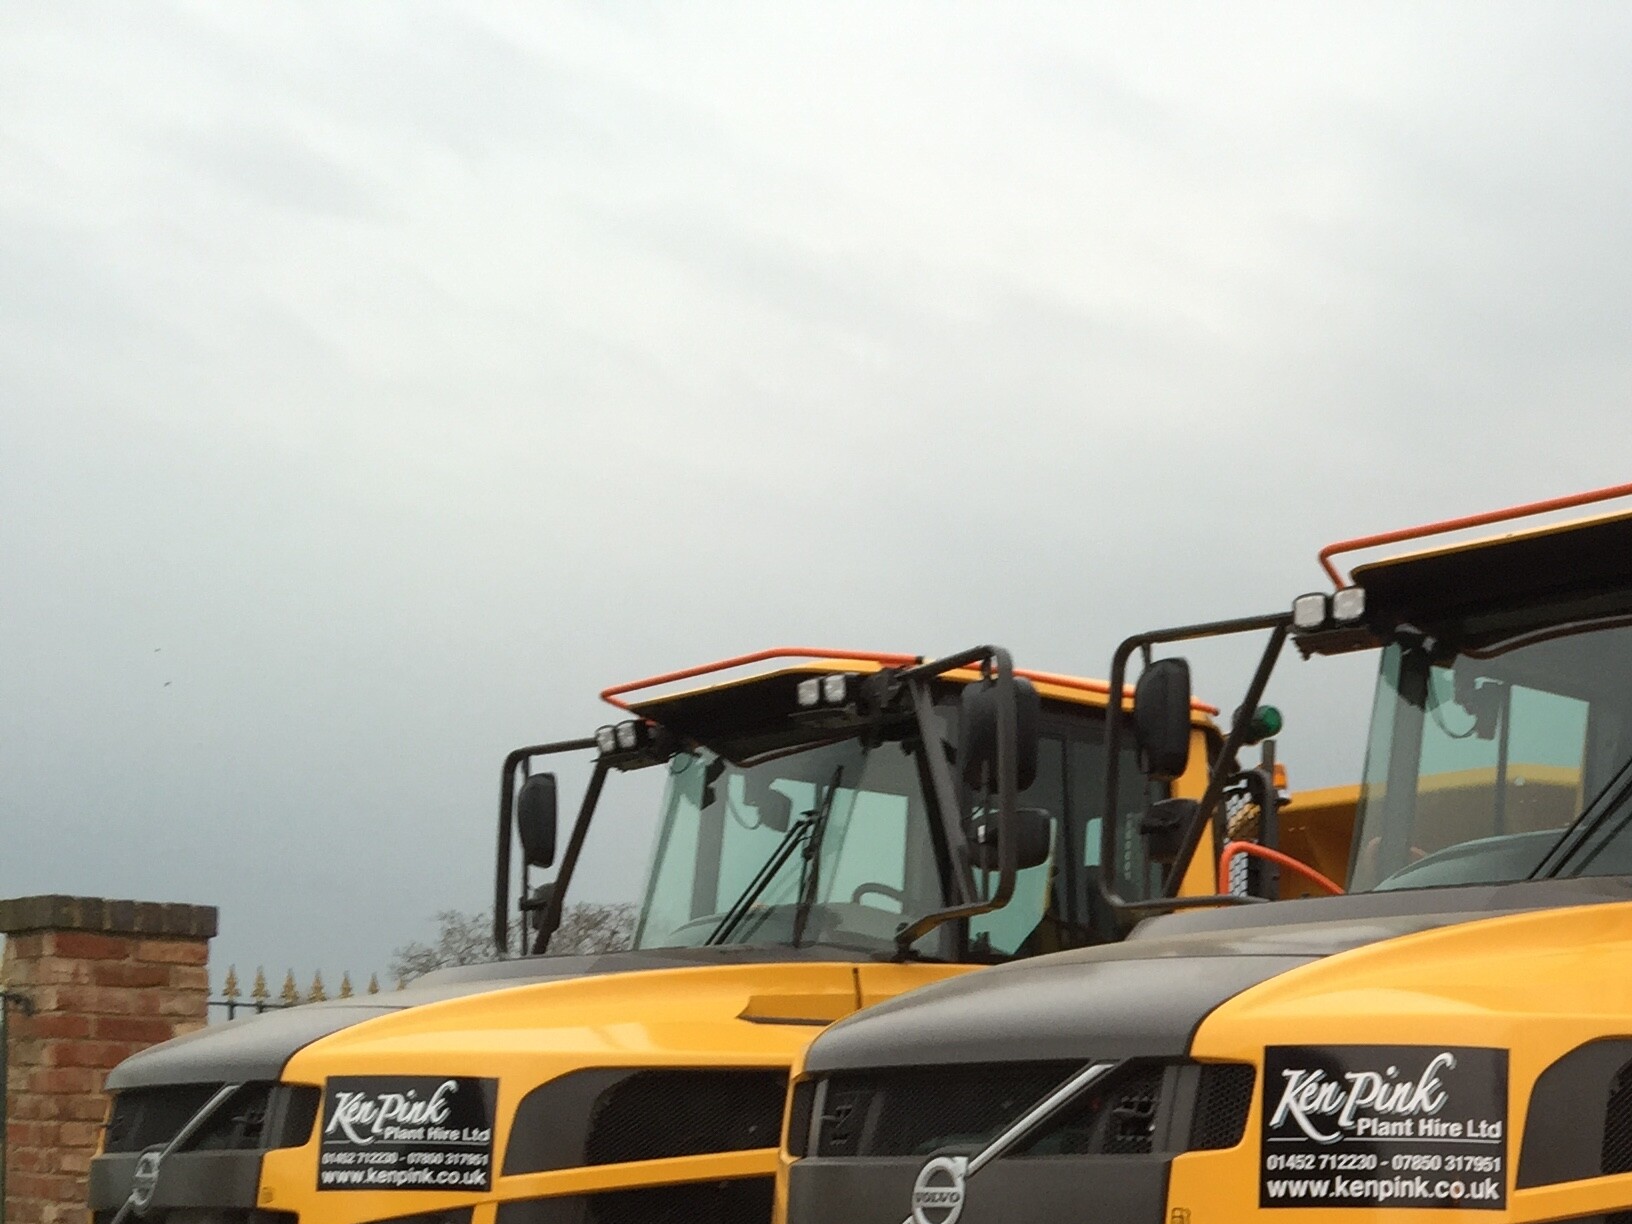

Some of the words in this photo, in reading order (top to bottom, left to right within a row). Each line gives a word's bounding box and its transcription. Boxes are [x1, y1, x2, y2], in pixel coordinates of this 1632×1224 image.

[1268, 1068, 1348, 1146] Ken
[1337, 1052, 1457, 1129] Pink
[324, 1091, 380, 1146] Ken
[371, 1079, 459, 1135] Pink
[383, 1125, 425, 1140] Plant
[427, 1126, 461, 1141] Hire
[462, 1127, 491, 1142] Ltd
[1357, 1117, 1414, 1137] Plant
[1418, 1118, 1462, 1137] Hire
[1467, 1119, 1503, 1139] Ltd
[1266, 1154, 1315, 1170] 01452
[1318, 1154, 1377, 1170] 712230
[1391, 1154, 1442, 1171] 07850
[1444, 1155, 1501, 1172] 317951
[321, 1167, 487, 1186] www.kenpink.co.uk
[915, 1191, 962, 1204] VOLVO
[1266, 1174, 1501, 1202] www.kenpink.co.uk
